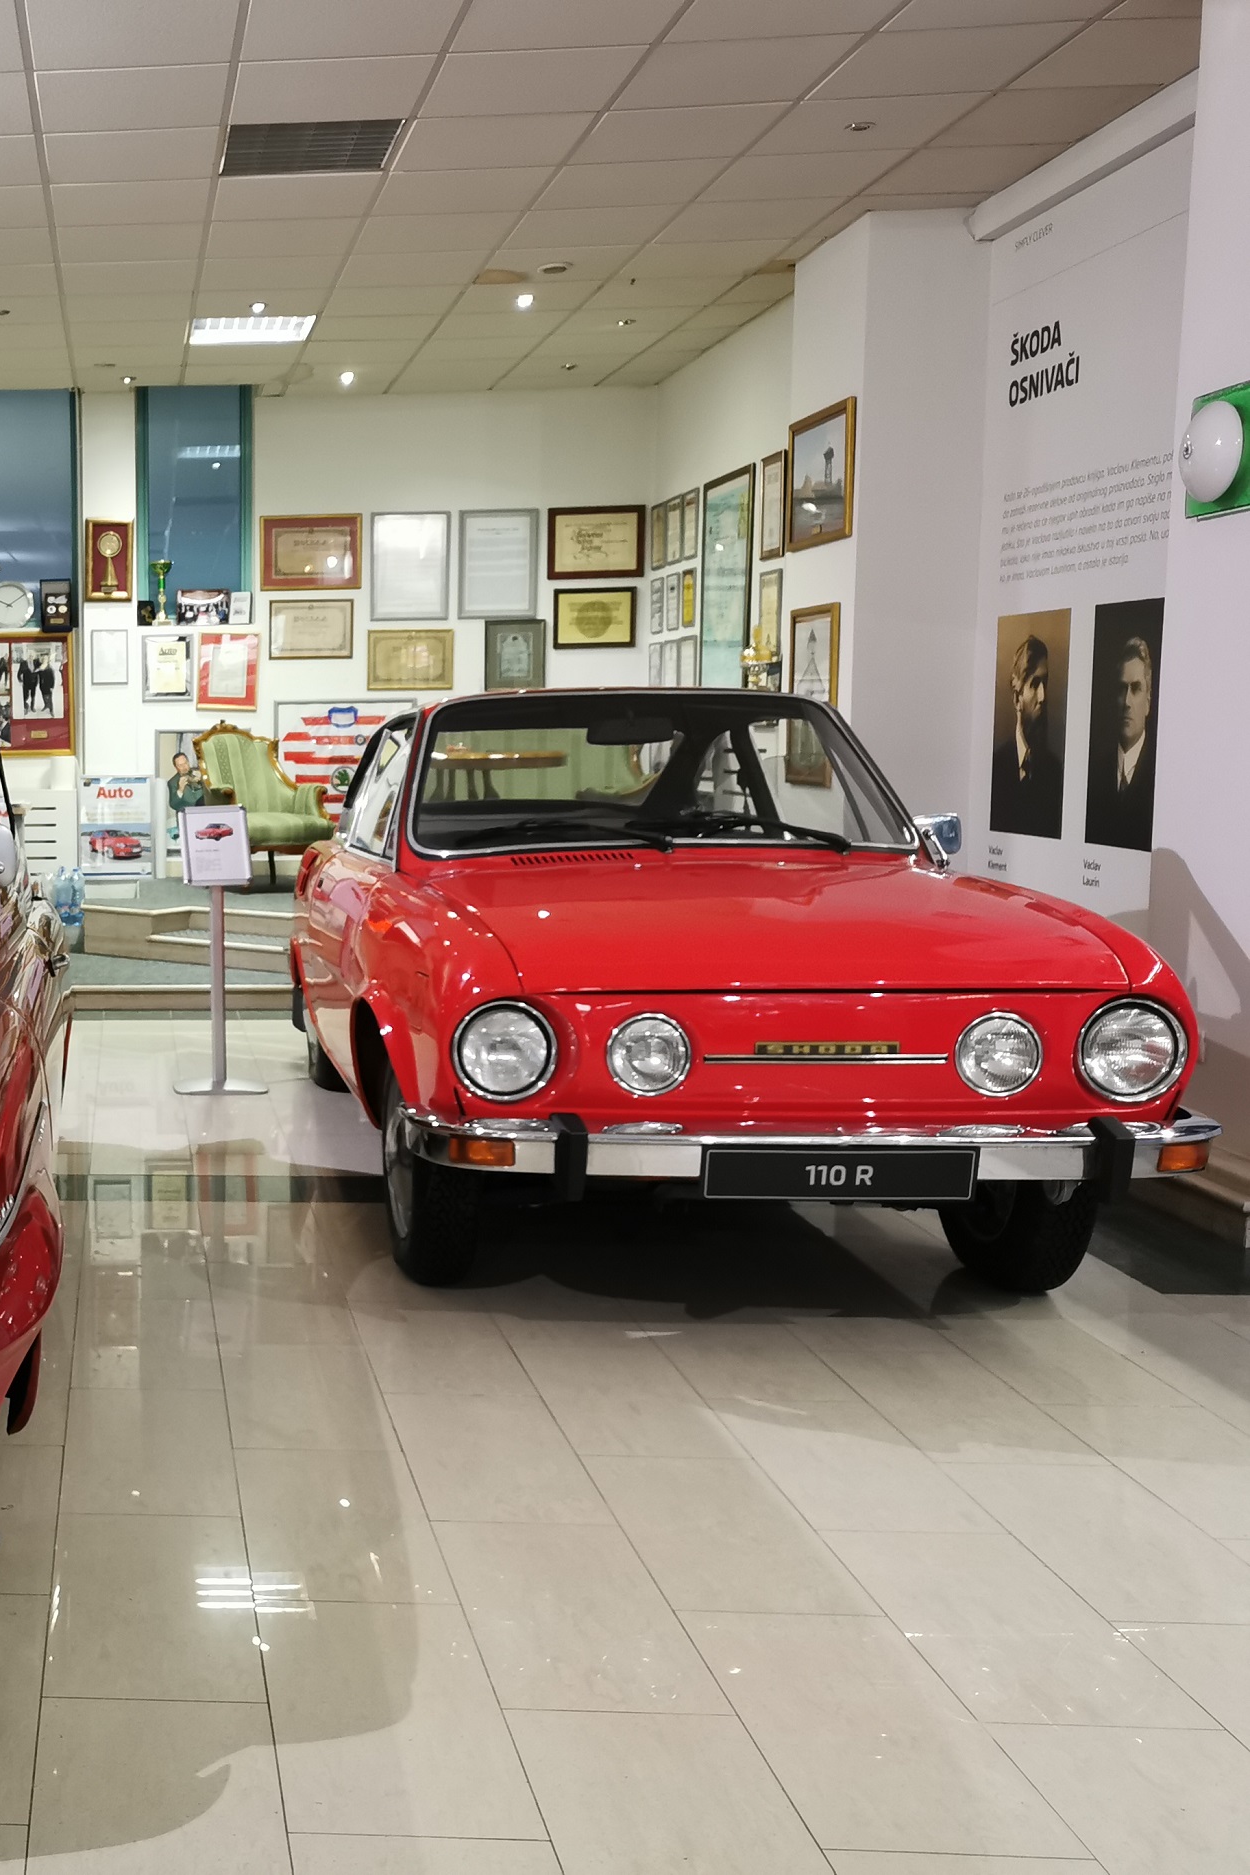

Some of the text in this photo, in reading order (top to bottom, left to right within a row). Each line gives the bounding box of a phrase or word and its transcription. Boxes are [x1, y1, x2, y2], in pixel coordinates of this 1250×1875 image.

[1010, 320, 1062, 366] ŠKODA
[1008, 351, 1080, 408] OSNIVAČI
[96, 786, 134, 799] Auto
[1083, 858, 1101, 872] Vaclav
[1082, 875, 1100, 888] Laurin
[804, 1165, 875, 1187] 110 R
